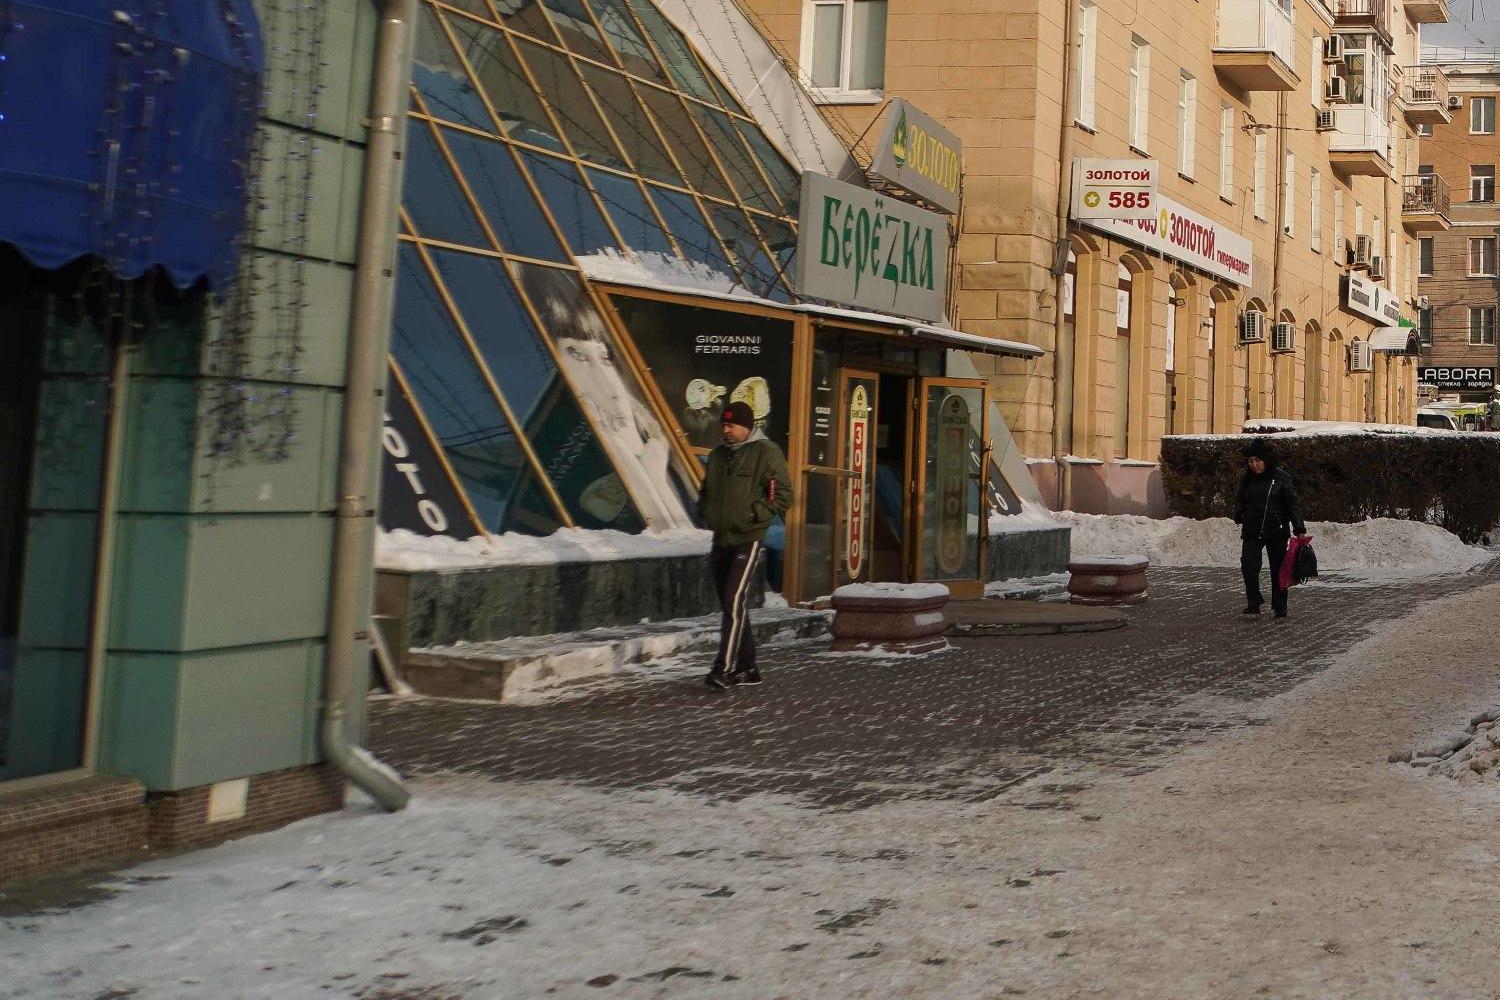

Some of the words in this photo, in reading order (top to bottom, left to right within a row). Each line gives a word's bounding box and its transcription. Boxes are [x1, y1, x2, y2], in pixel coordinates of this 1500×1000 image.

[1086, 168, 1150, 181] ЗОЛОТОЙ
[1108, 191, 1150, 209] 585
[1170, 212, 1216, 261] ЗОЛОТОЙ
[1216, 249, 1251, 276] гипермаркет
[696, 335, 762, 344] GIOVANNI
[695, 345, 760, 355] FERRARIS
[1418, 368, 1492, 380] ABORA
